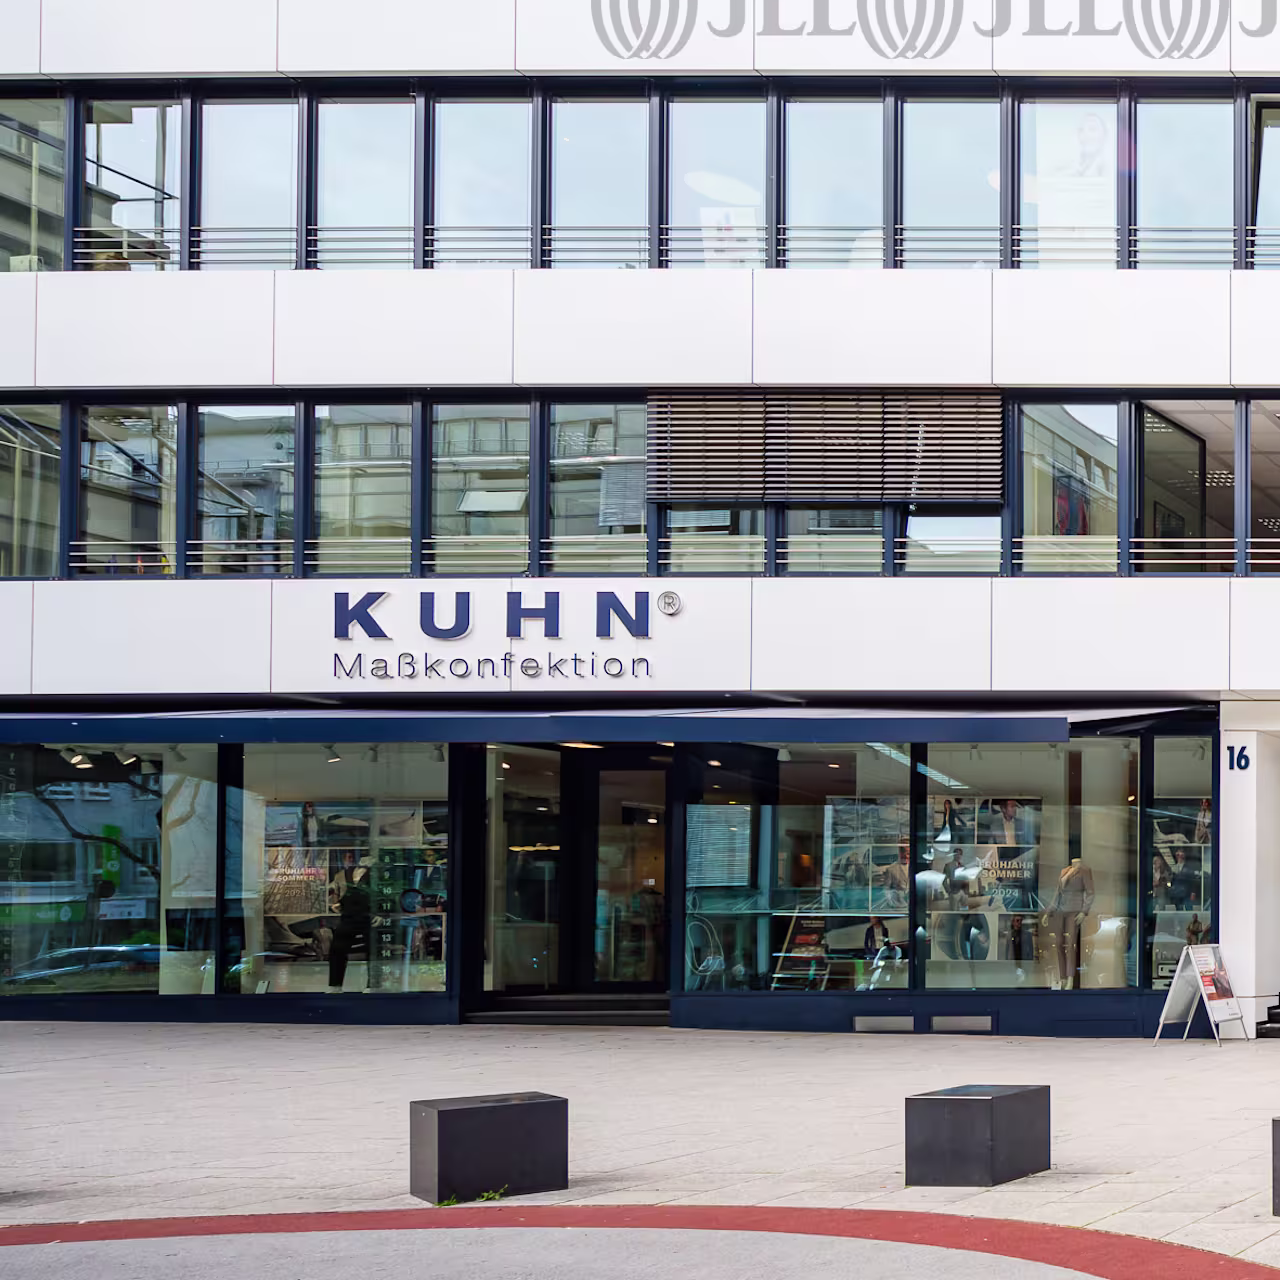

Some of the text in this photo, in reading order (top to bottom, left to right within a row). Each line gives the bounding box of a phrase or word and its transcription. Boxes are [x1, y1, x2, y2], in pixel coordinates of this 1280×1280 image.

[333, 652, 653, 679] Maßkonfektion
[1227, 746, 1250, 770] 16
[981, 869, 1032, 878] SOMMER
